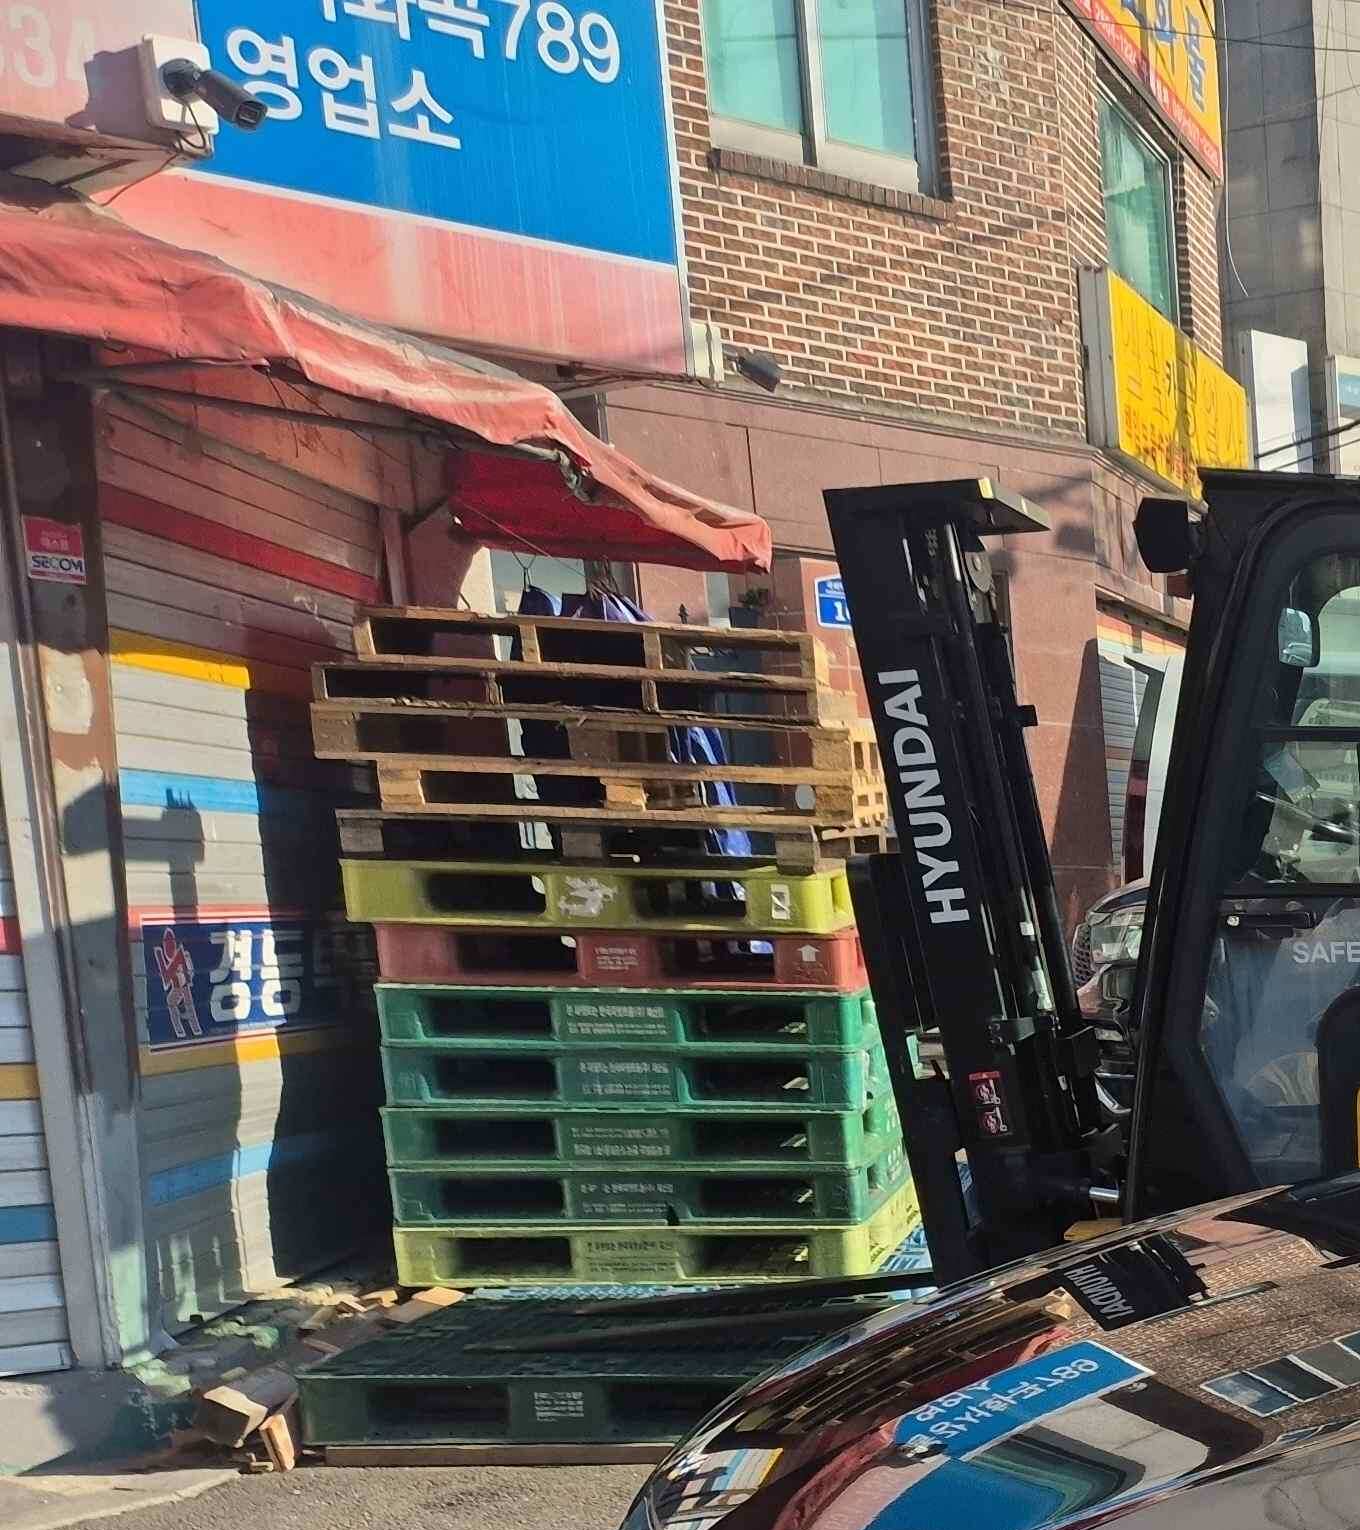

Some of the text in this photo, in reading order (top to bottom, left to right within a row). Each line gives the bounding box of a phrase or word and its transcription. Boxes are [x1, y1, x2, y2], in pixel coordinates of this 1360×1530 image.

[226, 28, 461, 150] 영업소
[32, 555, 83, 572] SECOM
[878, 669, 970, 924] HYUNDAI
